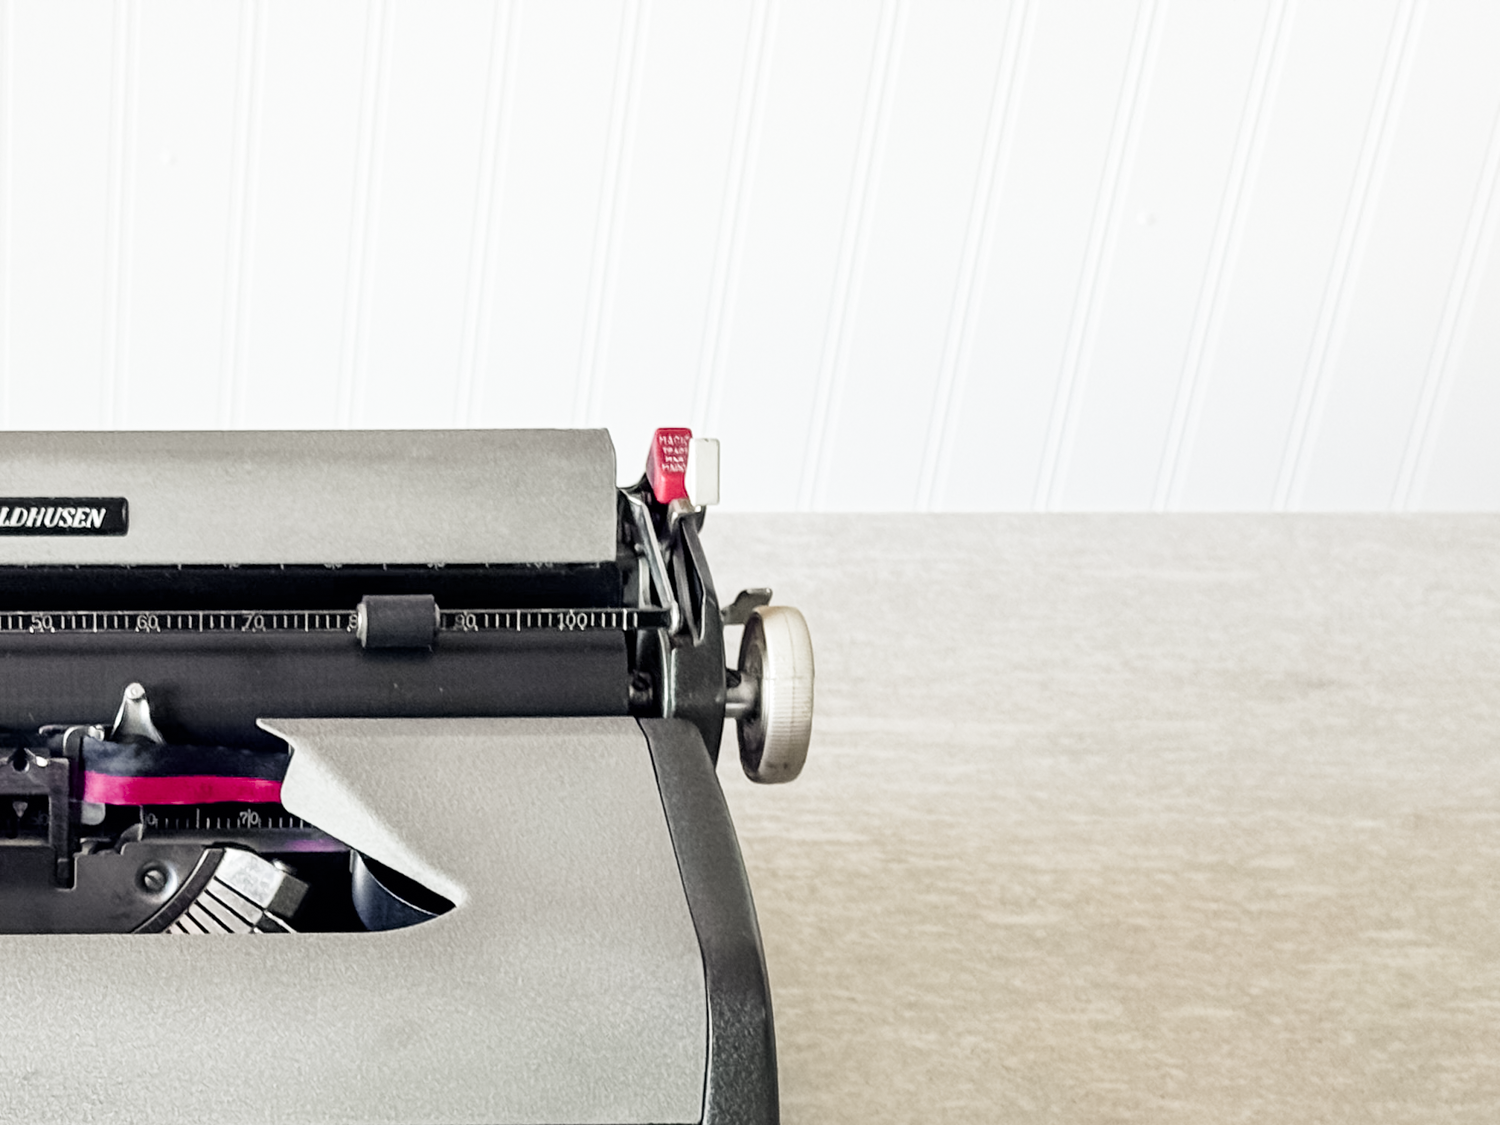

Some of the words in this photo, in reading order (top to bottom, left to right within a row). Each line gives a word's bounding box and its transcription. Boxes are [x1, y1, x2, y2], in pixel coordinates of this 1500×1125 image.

[30, 614, 53, 630] 50
[137, 614, 160, 630] 60
[243, 614, 265, 630] 70
[455, 613, 477, 630] 90
[557, 612, 588, 630] 100
[239, 810, 260, 825] 70
